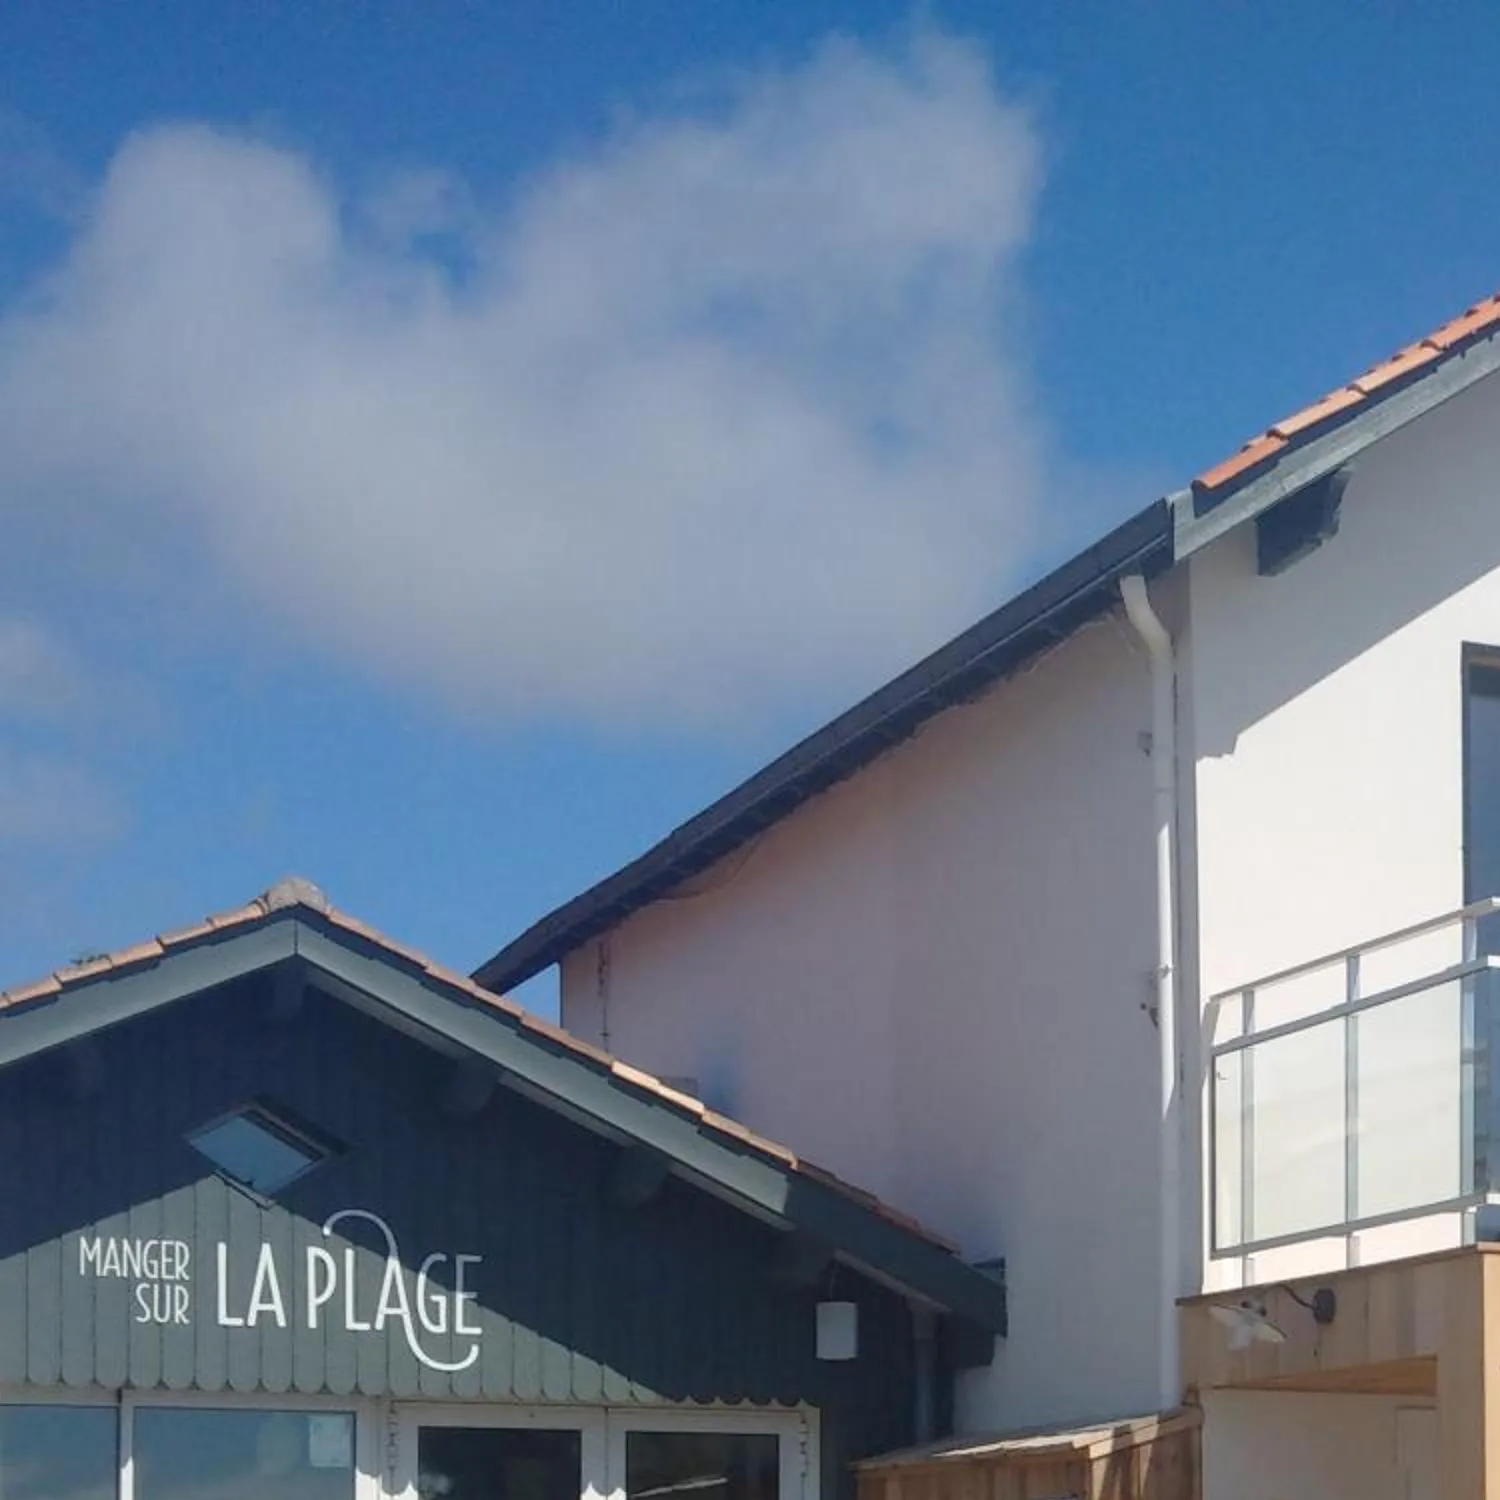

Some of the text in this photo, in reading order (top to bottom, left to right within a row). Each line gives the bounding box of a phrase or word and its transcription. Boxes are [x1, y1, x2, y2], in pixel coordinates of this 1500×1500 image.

[79, 1237, 190, 1281] MANGER
[136, 1284, 190, 1325] SUR
[217, 1209, 483, 1372] LA PLAGE
